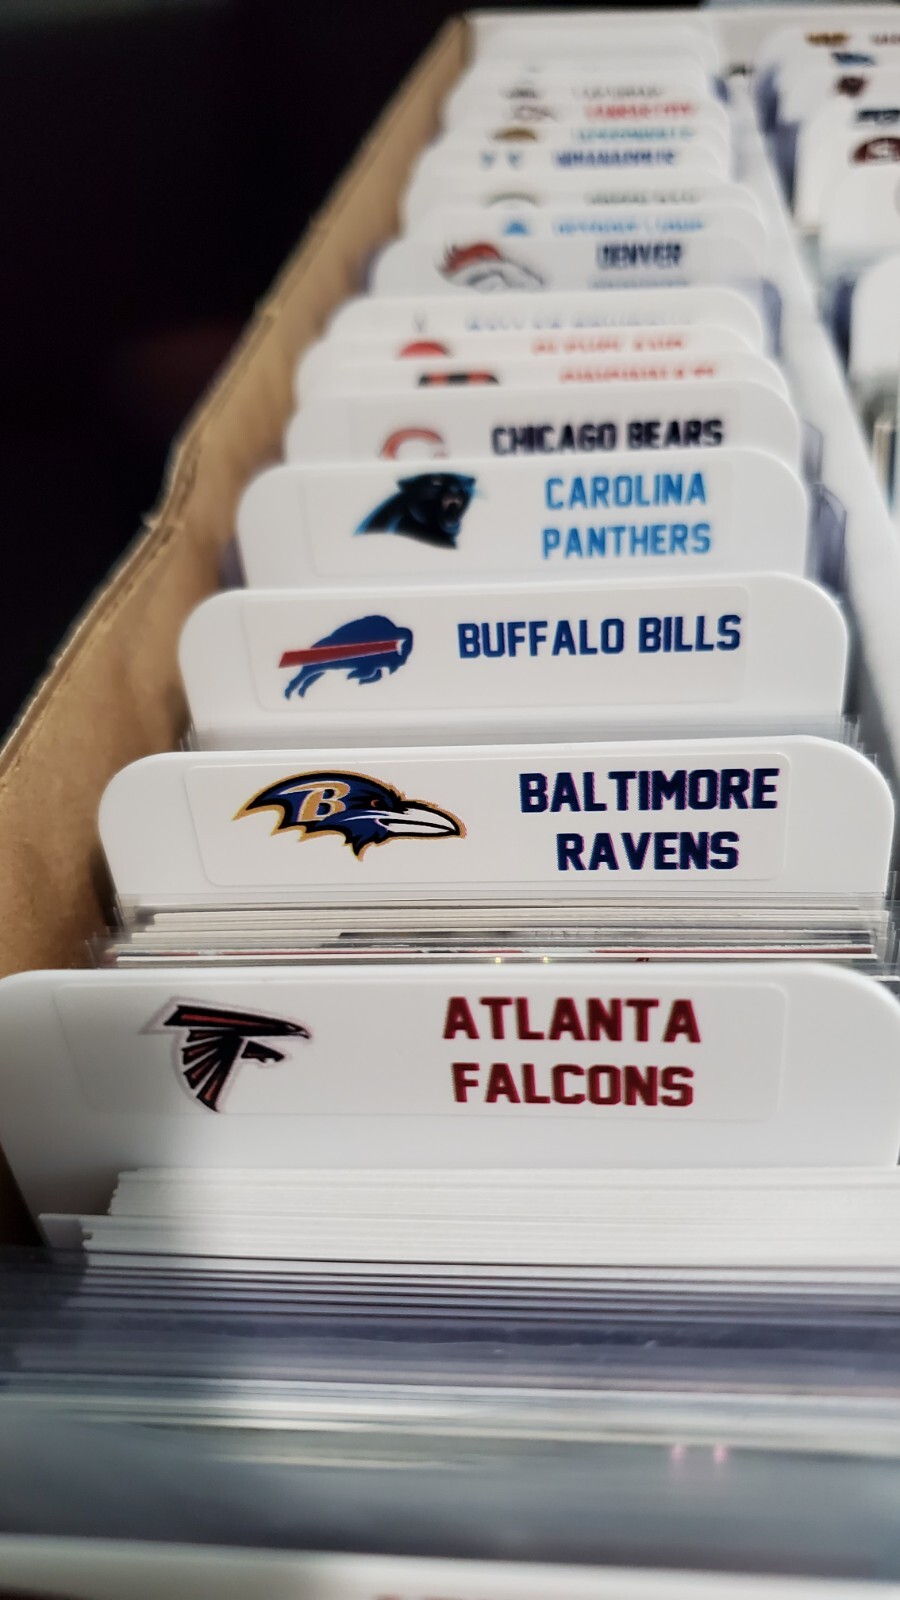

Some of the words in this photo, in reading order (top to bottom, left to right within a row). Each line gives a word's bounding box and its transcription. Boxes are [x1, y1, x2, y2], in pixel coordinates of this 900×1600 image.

[492, 421, 617, 456] CHICAGO
[628, 418, 724, 450] BEARS
[546, 471, 706, 510] CAROLINA
[542, 522, 711, 559] PANTHERS
[457, 618, 624, 658] BUFFALO
[639, 614, 741, 653] BILLS
[519, 768, 780, 813] BALTIMORE
[556, 831, 739, 871] RAVENS
[442, 996, 701, 1043] ATLANTA
[451, 1062, 694, 1107] FALCONS
